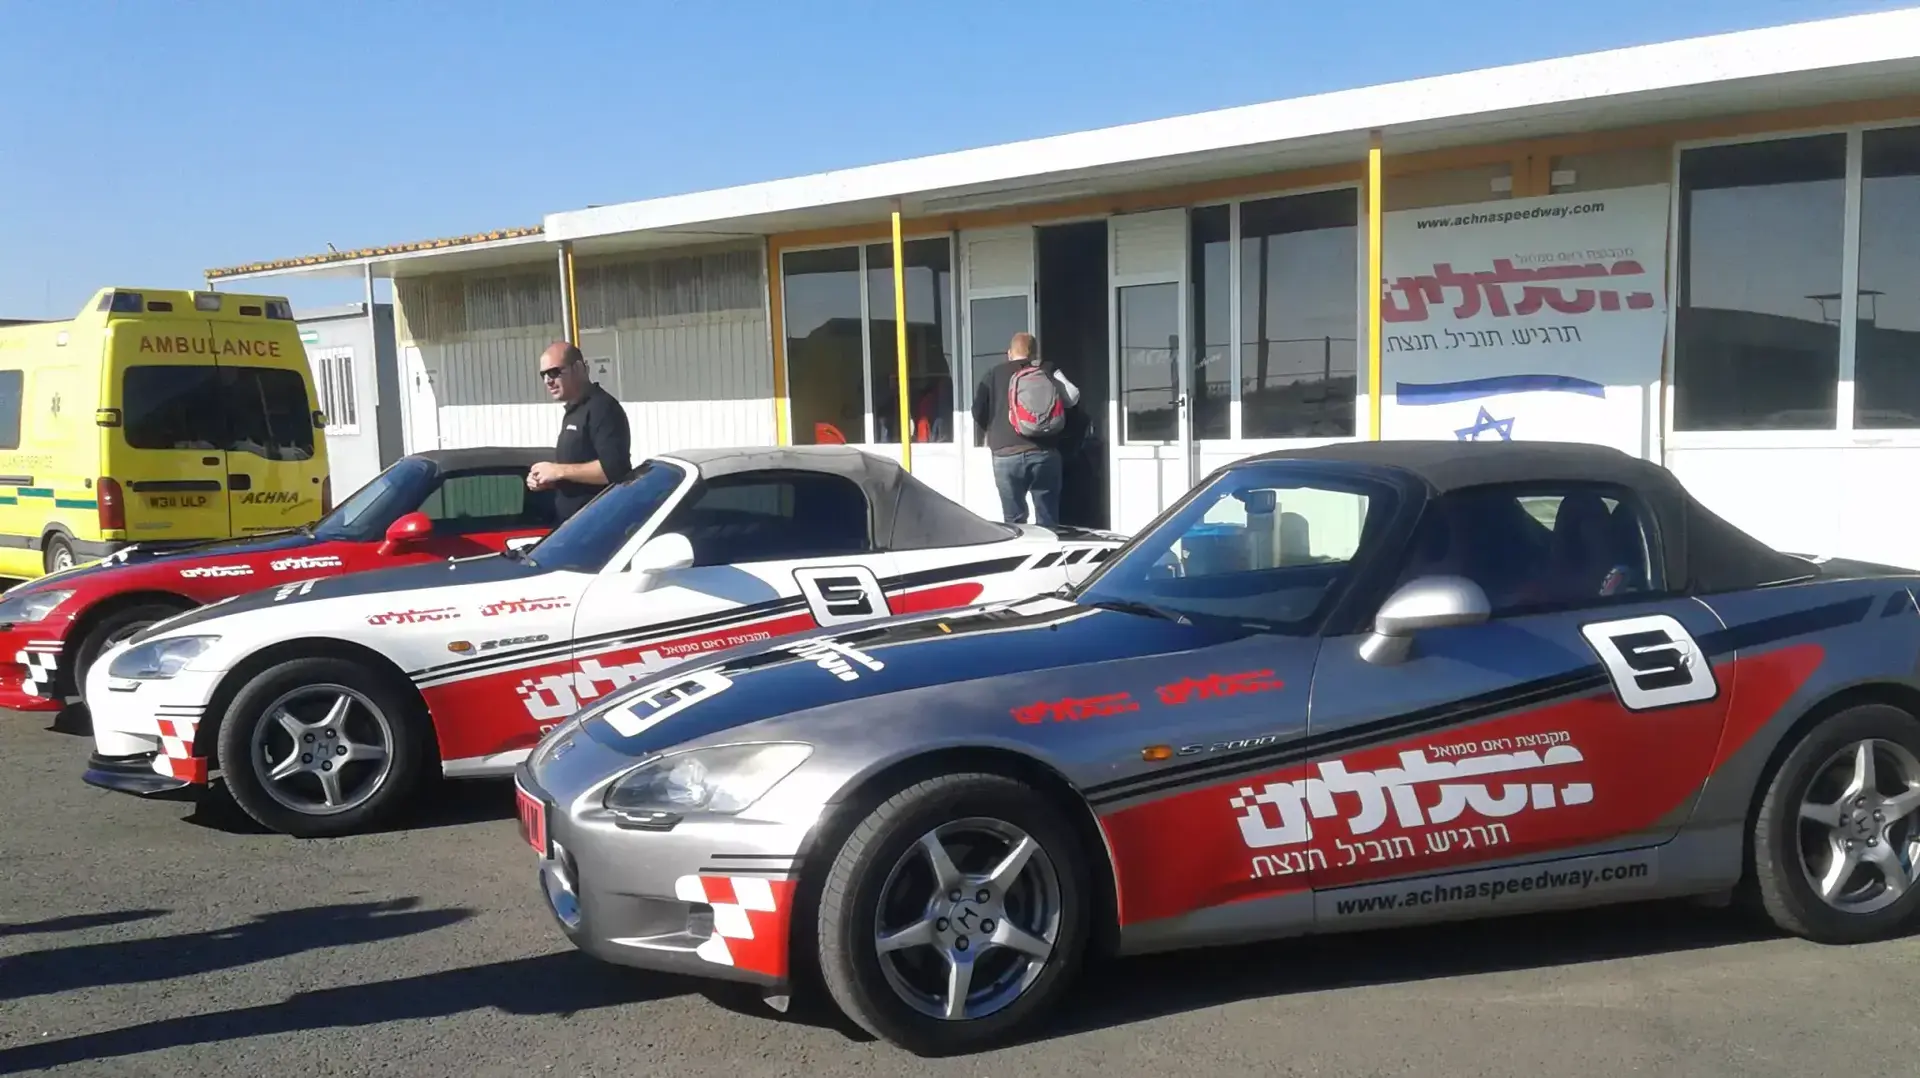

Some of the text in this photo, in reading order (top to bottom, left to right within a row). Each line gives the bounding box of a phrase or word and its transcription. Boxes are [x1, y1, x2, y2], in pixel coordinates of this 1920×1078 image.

[1417, 201, 1605, 230] www.achnaspeedway.com
[139, 335, 282, 358] AMBULANCE
[1385, 324, 1583, 353] תרגיש. תוביל. תנצח.
[242, 490, 299, 505] ACHNA
[660, 642, 699, 656] סמואל
[1428, 730, 1570, 759] מקבוצת ראם סמואל
[1249, 821, 1511, 880] תרגיש. תוביל. תנצח.
[1336, 861, 1648, 916] www.achnaspeedway.com
